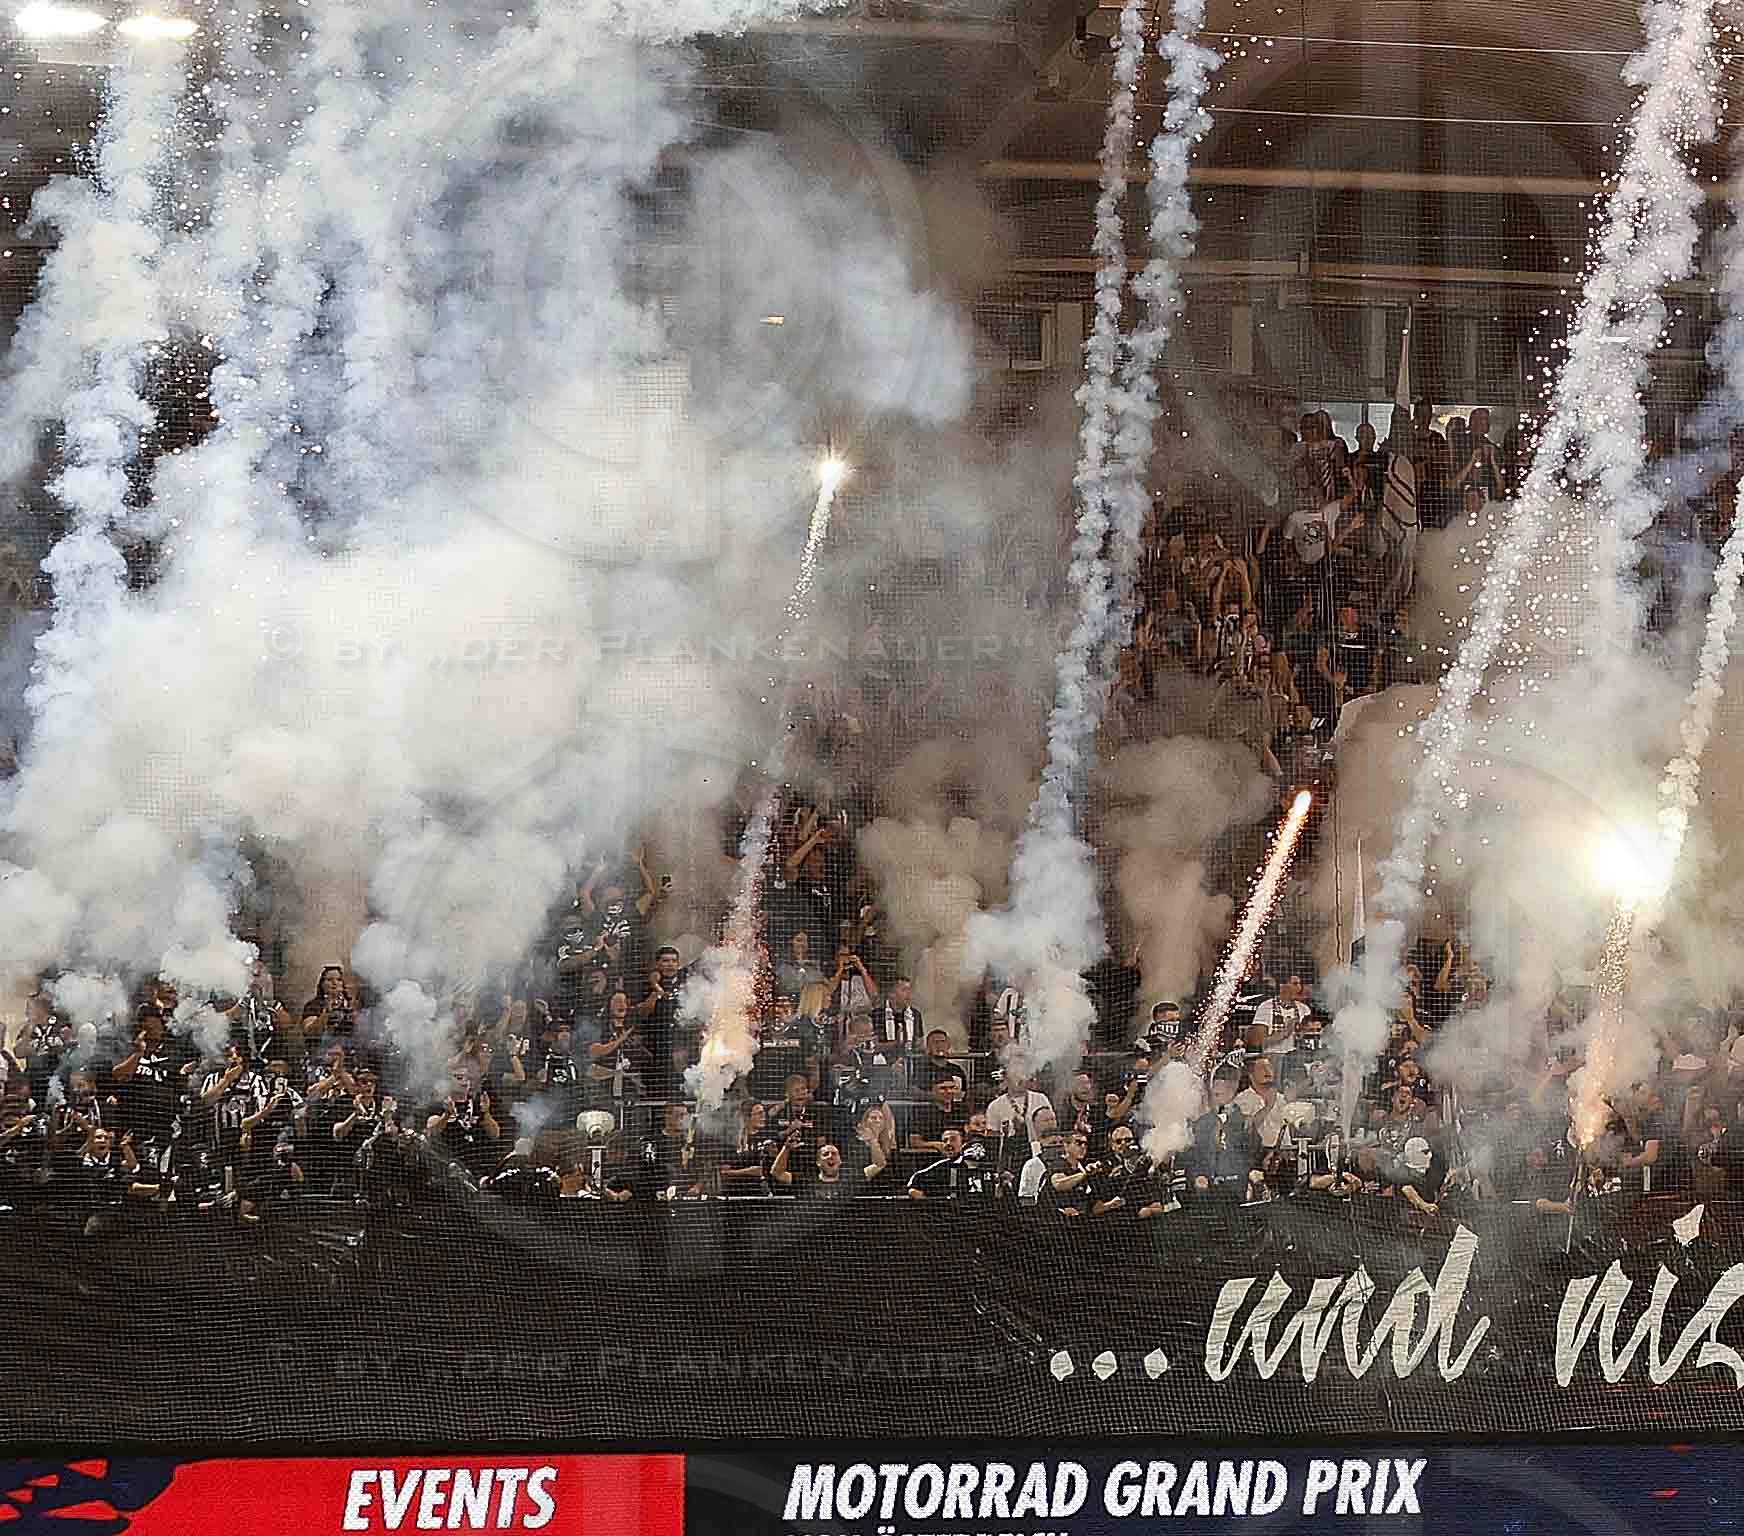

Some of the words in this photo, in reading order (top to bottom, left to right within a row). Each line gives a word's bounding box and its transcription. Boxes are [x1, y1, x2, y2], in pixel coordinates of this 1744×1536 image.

[1205, 1224, 1492, 1382] und
[341, 1466, 559, 1531] EVENTS
[782, 1462, 1090, 1521] MOTORRAD
[1101, 1460, 1287, 1519] GRAND
[1302, 1457, 1429, 1516] PRIX
